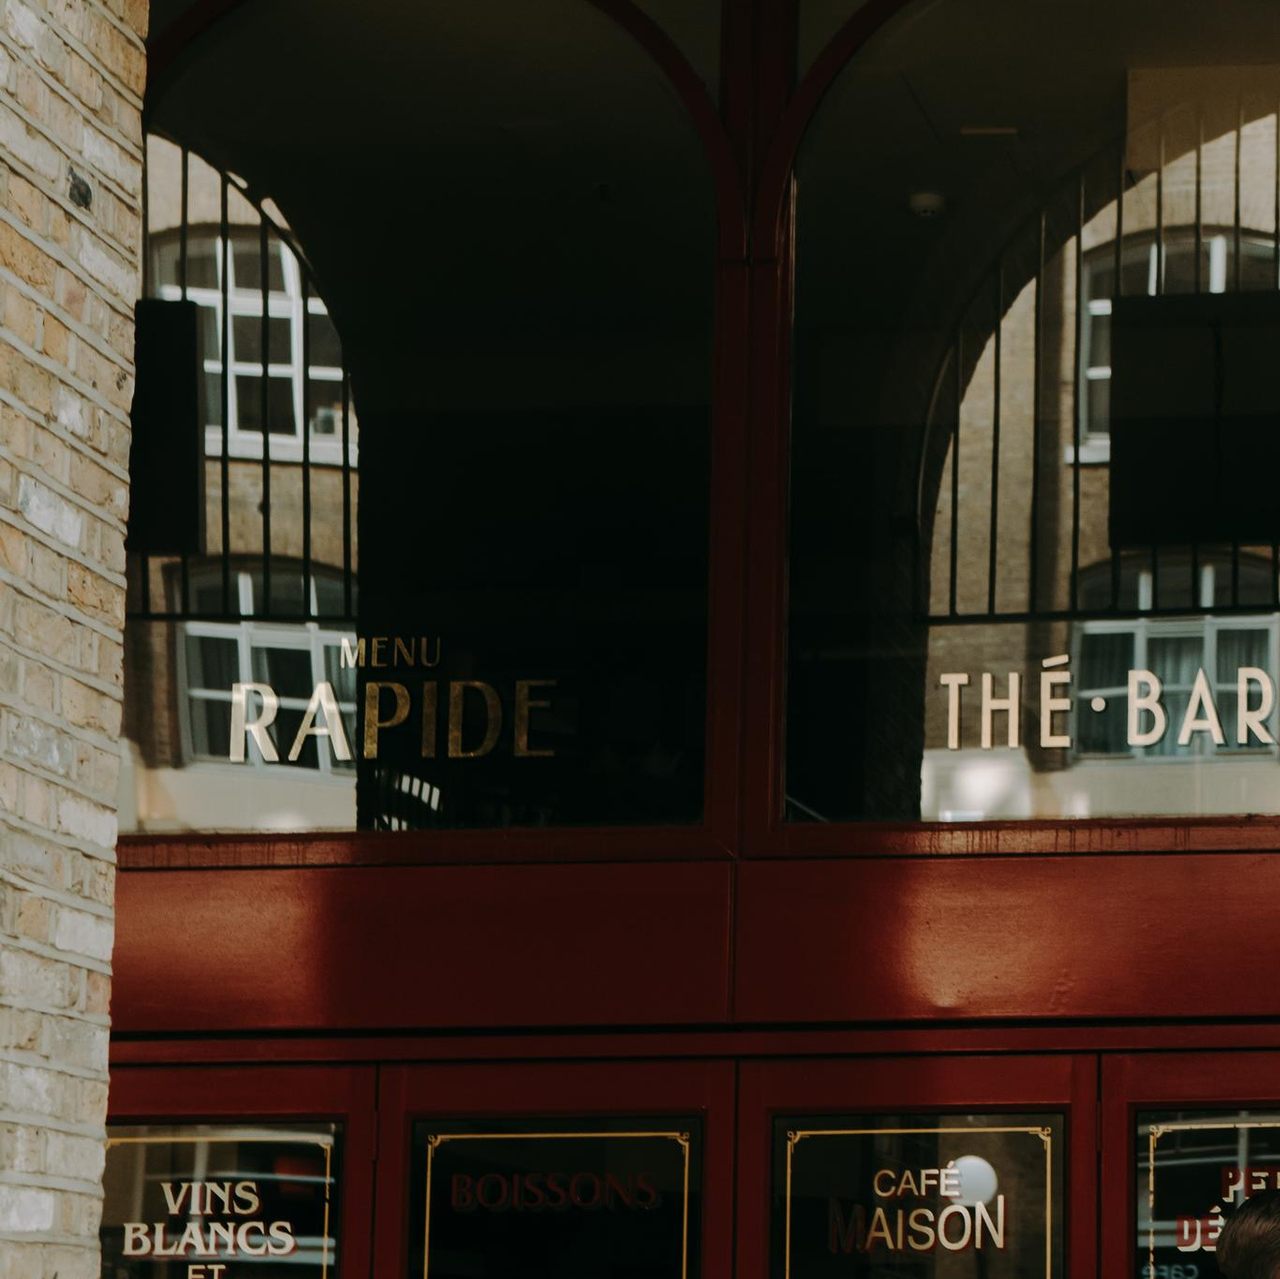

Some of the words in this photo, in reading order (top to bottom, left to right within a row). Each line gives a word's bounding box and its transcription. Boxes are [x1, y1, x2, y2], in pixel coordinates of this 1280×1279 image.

[339, 636, 442, 670] MENU
[229, 679, 557, 763] RAPIDE
[160, 1180, 261, 1216] VINS
[450, 1170, 663, 1215] BOISSONS
[872, 1159, 965, 1200] CAFÉ
[121, 1220, 299, 1258] BLANCS
[828, 1193, 1008, 1255] MAISON
